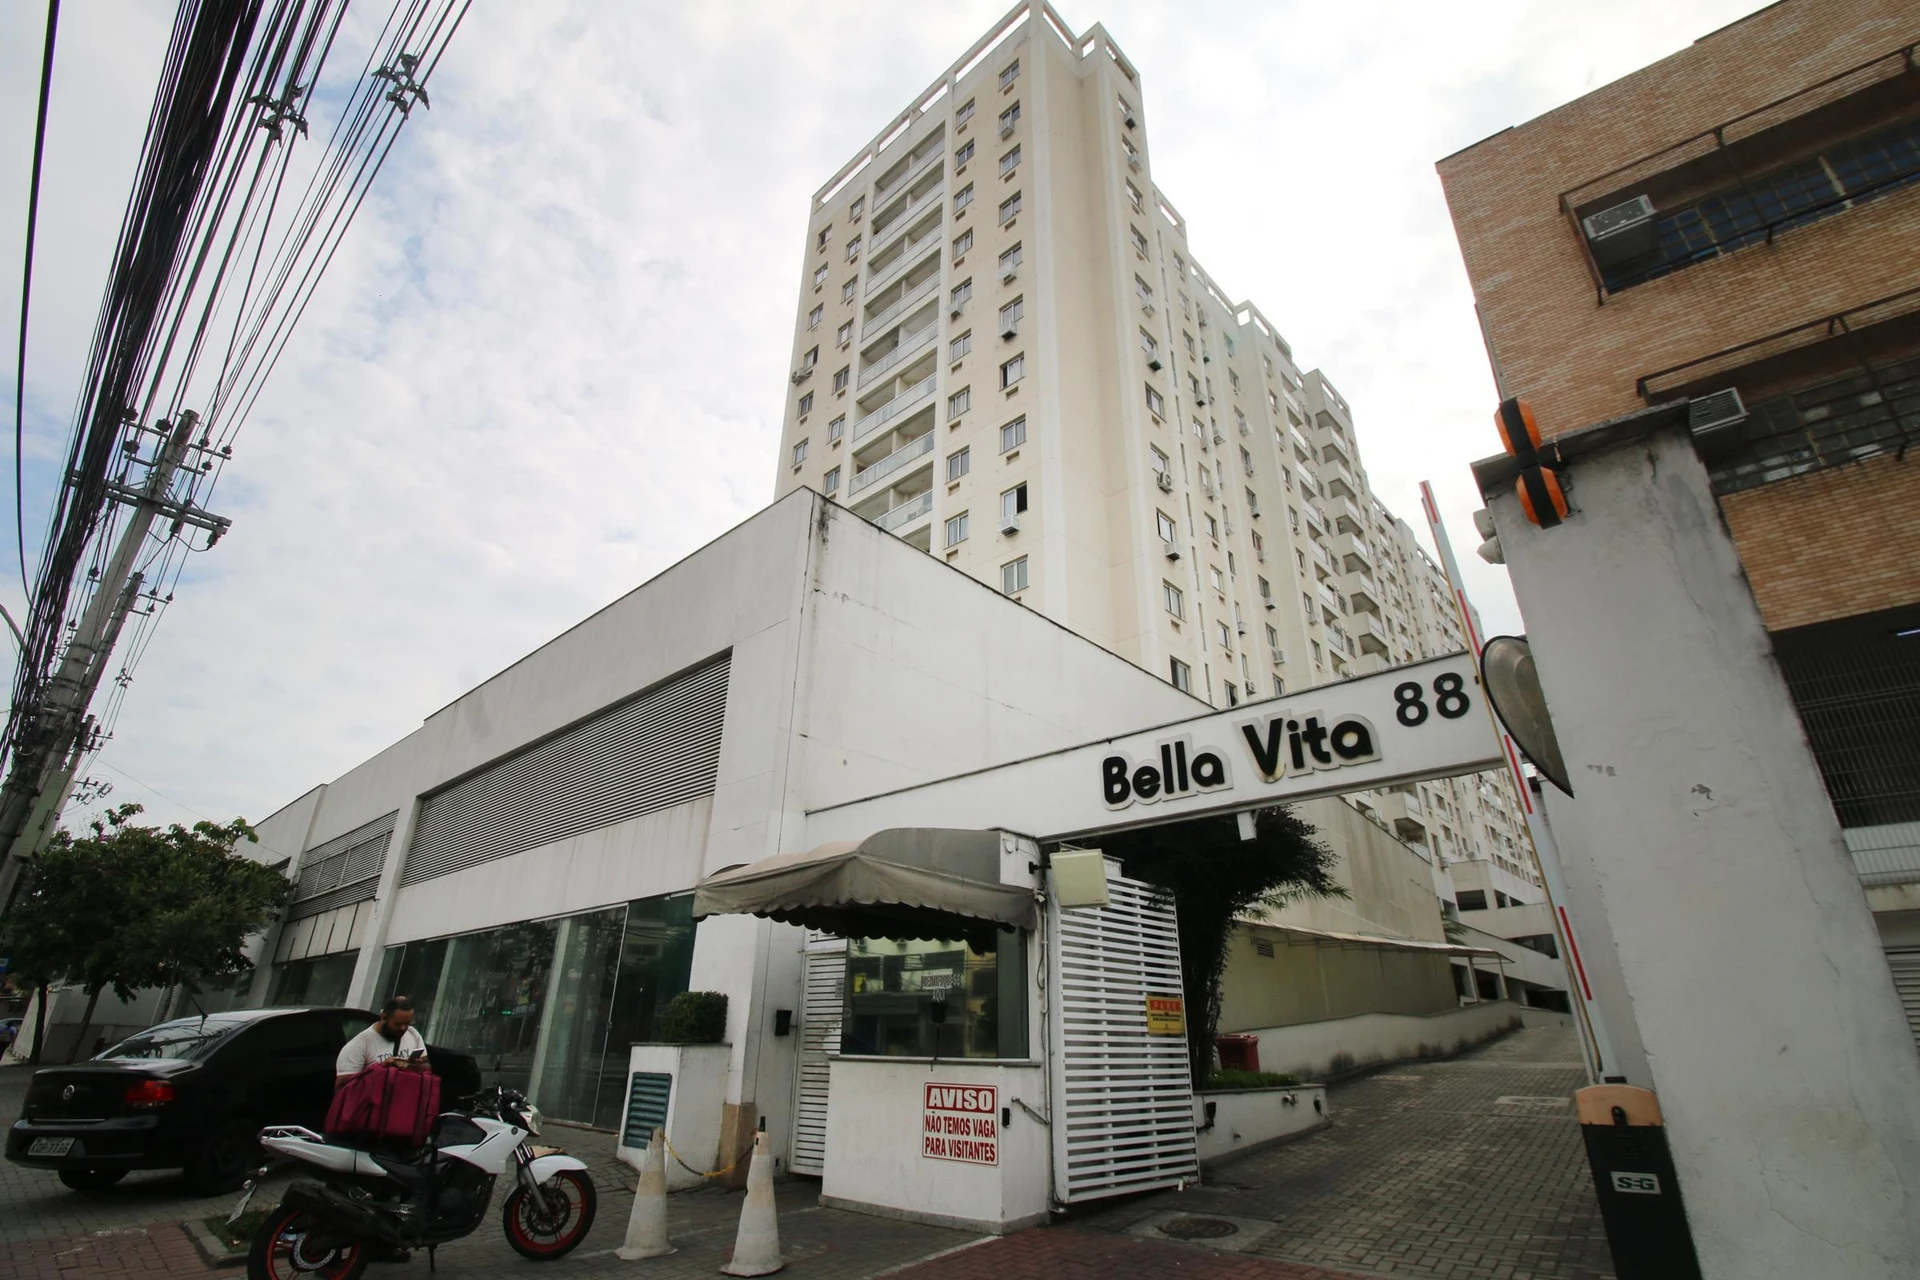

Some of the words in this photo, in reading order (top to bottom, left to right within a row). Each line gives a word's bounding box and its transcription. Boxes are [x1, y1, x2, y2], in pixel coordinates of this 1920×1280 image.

[1101, 739, 1225, 805] Bella
[1240, 716, 1374, 777] Vita
[1393, 671, 1471, 728] 88
[928, 1087, 993, 1111] AVISO
[925, 1111, 942, 1133] NÃO
[943, 1116, 971, 1136] TEMOS
[972, 1118, 996, 1139] VAGA
[925, 1136, 947, 1157] PARA
[948, 1139, 996, 1163] VISITANTES
